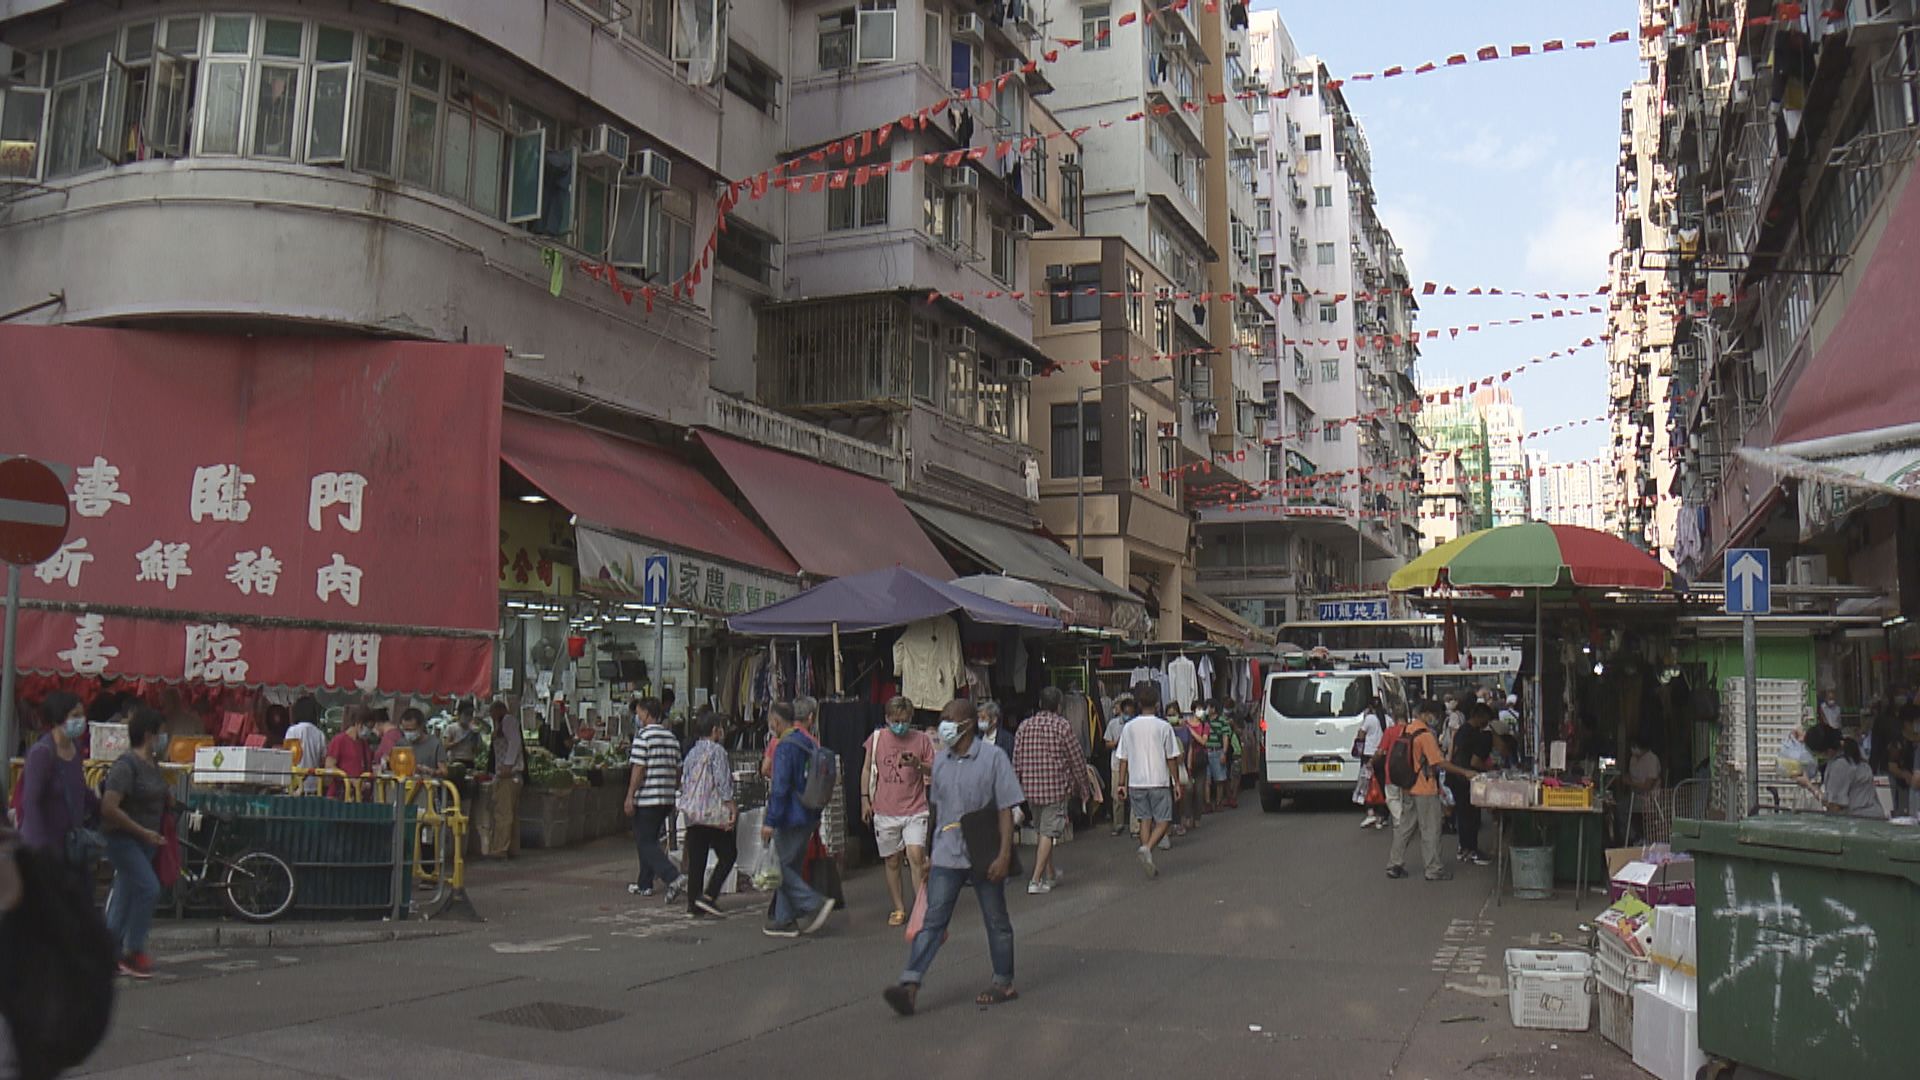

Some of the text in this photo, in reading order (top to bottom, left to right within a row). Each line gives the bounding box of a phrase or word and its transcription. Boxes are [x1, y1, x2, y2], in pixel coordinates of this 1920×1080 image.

[68, 455, 369, 532] 喜臨門
[34, 537, 364, 607] 新鮮豬肉
[56, 612, 382, 694] 喜臨門
